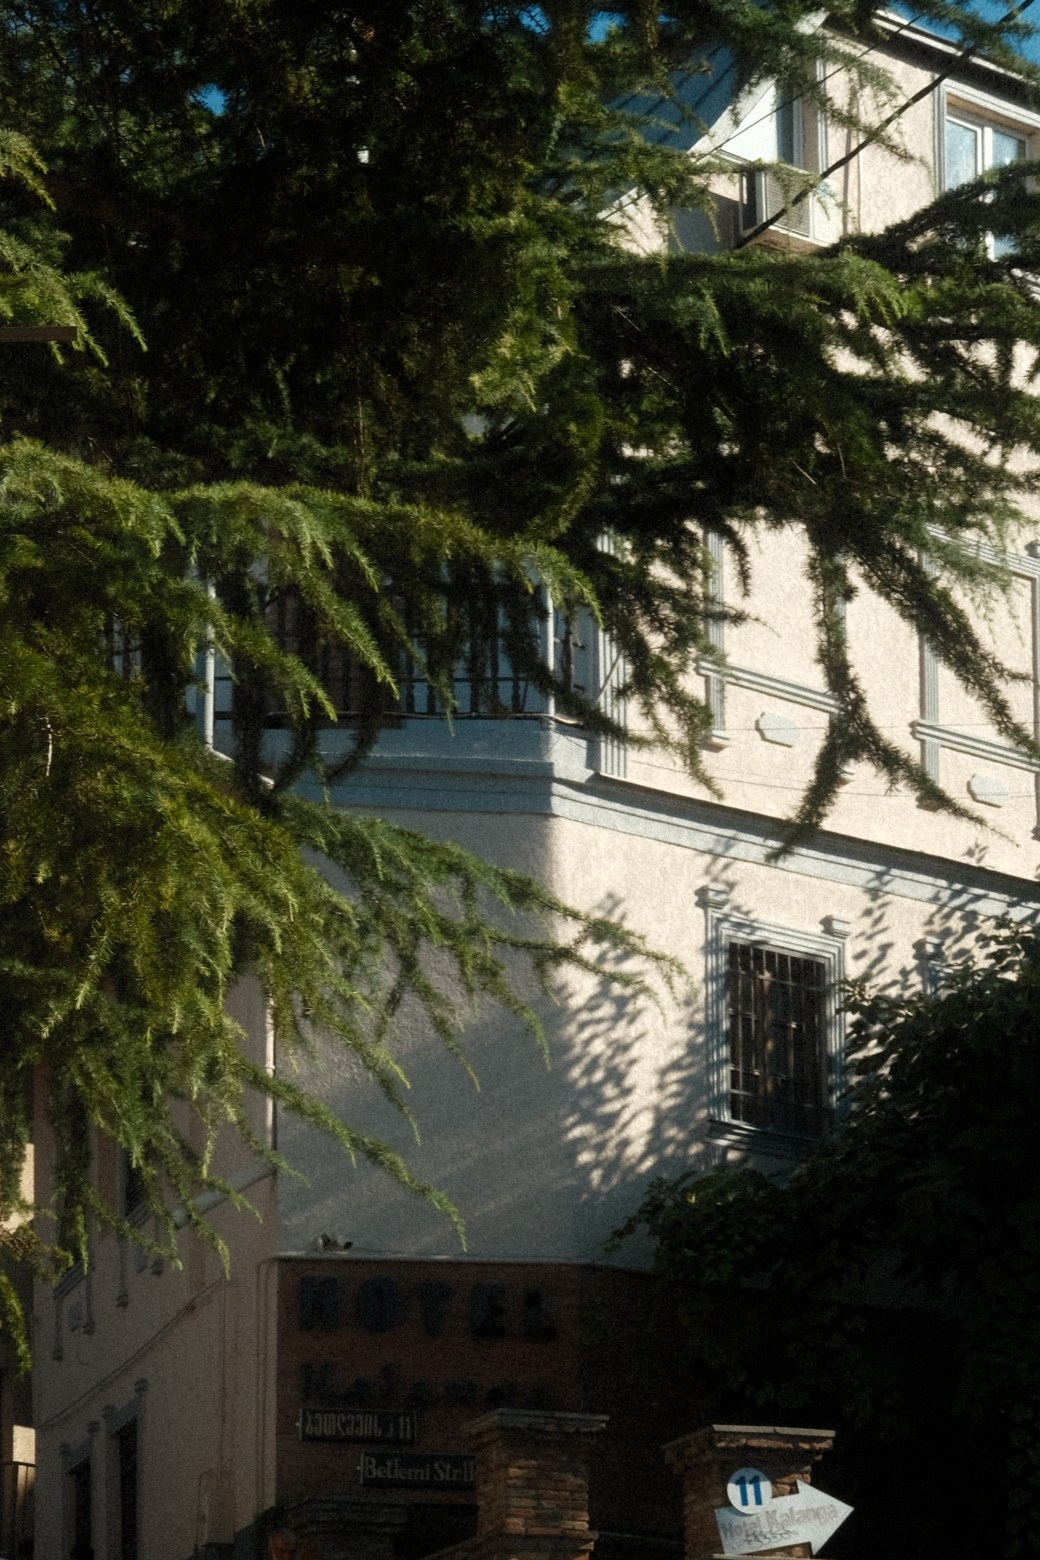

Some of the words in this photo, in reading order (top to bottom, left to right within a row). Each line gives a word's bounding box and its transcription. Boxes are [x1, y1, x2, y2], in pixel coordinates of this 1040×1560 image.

[299, 1275, 558, 1339] HOTEL
[399, 1415, 412, 1441] 11
[364, 1456, 431, 1481] Betlemi
[734, 1475, 763, 1507] 11
[721, 1515, 762, 1539] Hotel
[765, 1503, 838, 1530] Kalanga
